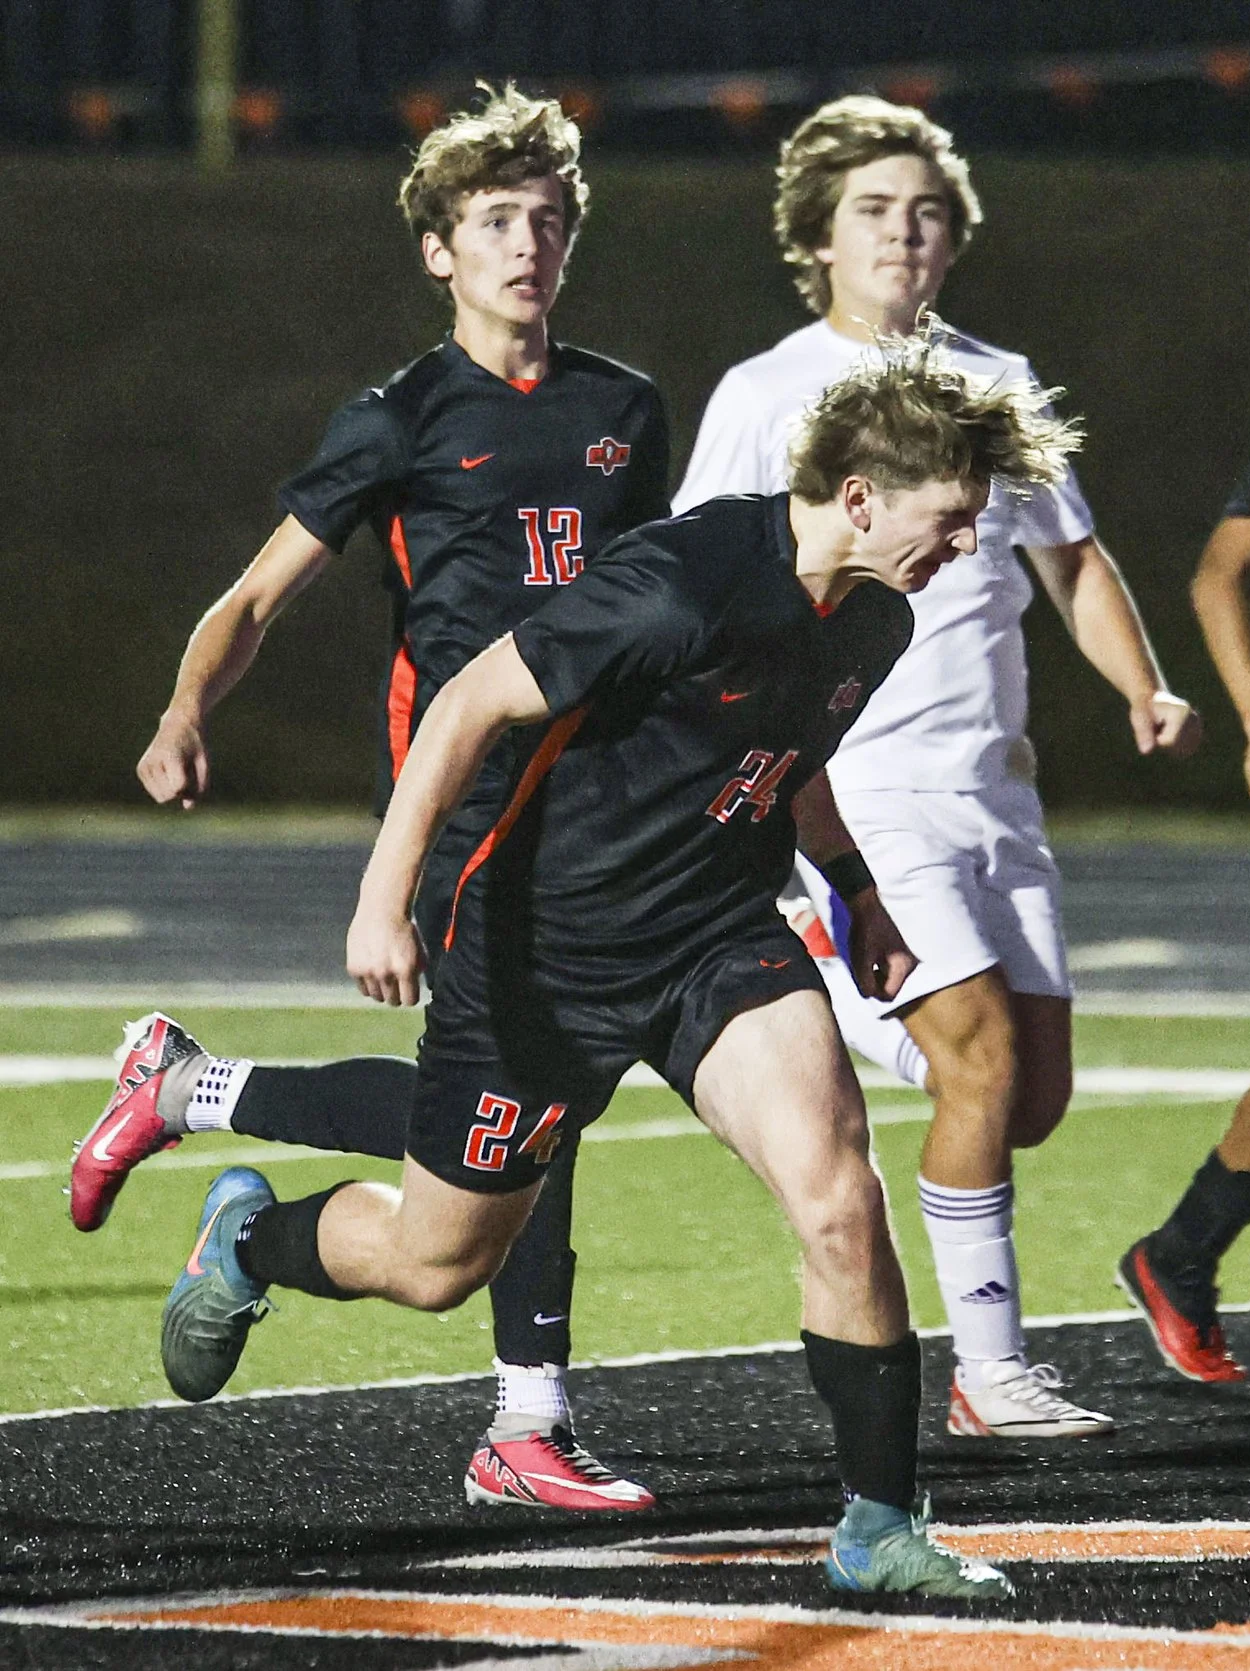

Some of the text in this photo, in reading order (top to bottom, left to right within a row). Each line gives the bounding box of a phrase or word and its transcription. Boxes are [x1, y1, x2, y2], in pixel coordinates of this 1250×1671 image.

[518, 508, 584, 585] 12
[705, 750, 798, 823] 24
[463, 1091, 568, 1171] 24
